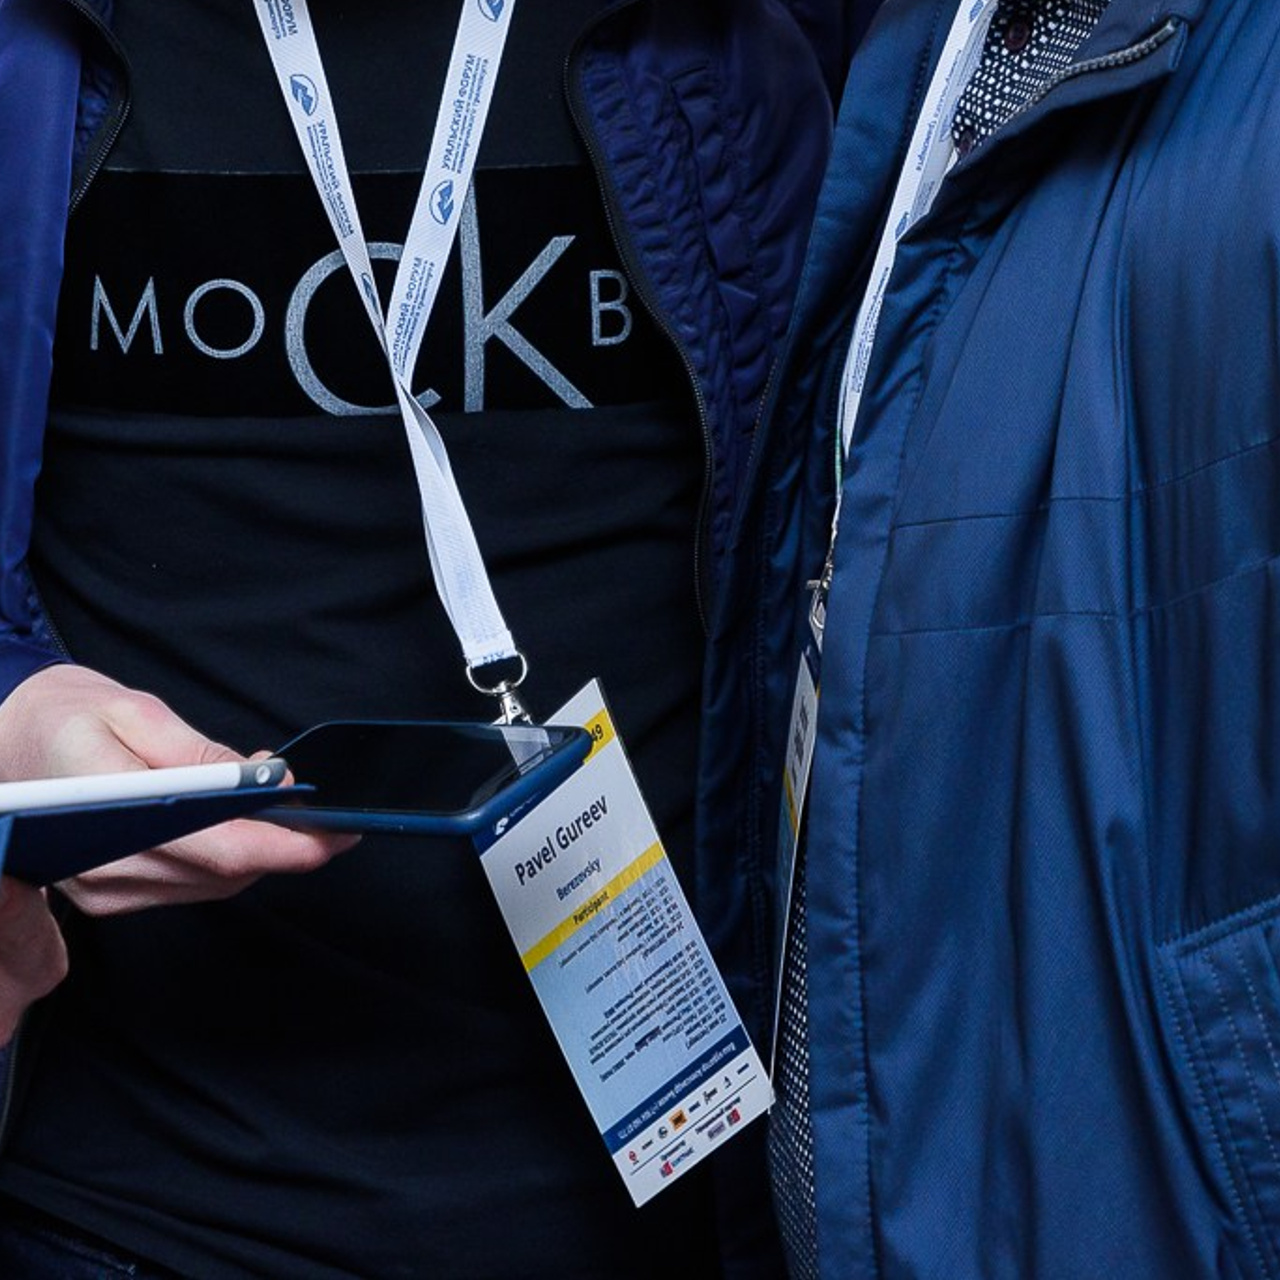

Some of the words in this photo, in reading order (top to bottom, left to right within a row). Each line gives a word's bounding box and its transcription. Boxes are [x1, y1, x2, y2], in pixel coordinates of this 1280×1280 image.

[441, 99, 464, 169] УРАЛЬСКИЙ
[458, 53, 475, 97] ФОРУМ
[316, 119, 339, 190] УРАЛЬСКИЙ
[405, 256, 421, 300] ФОРУМ
[515, 830, 556, 885] Pavel
[555, 795, 610, 857] Gureev
[556, 858, 601, 901] Berezovsky
[572, 891, 610, 924] Participant
